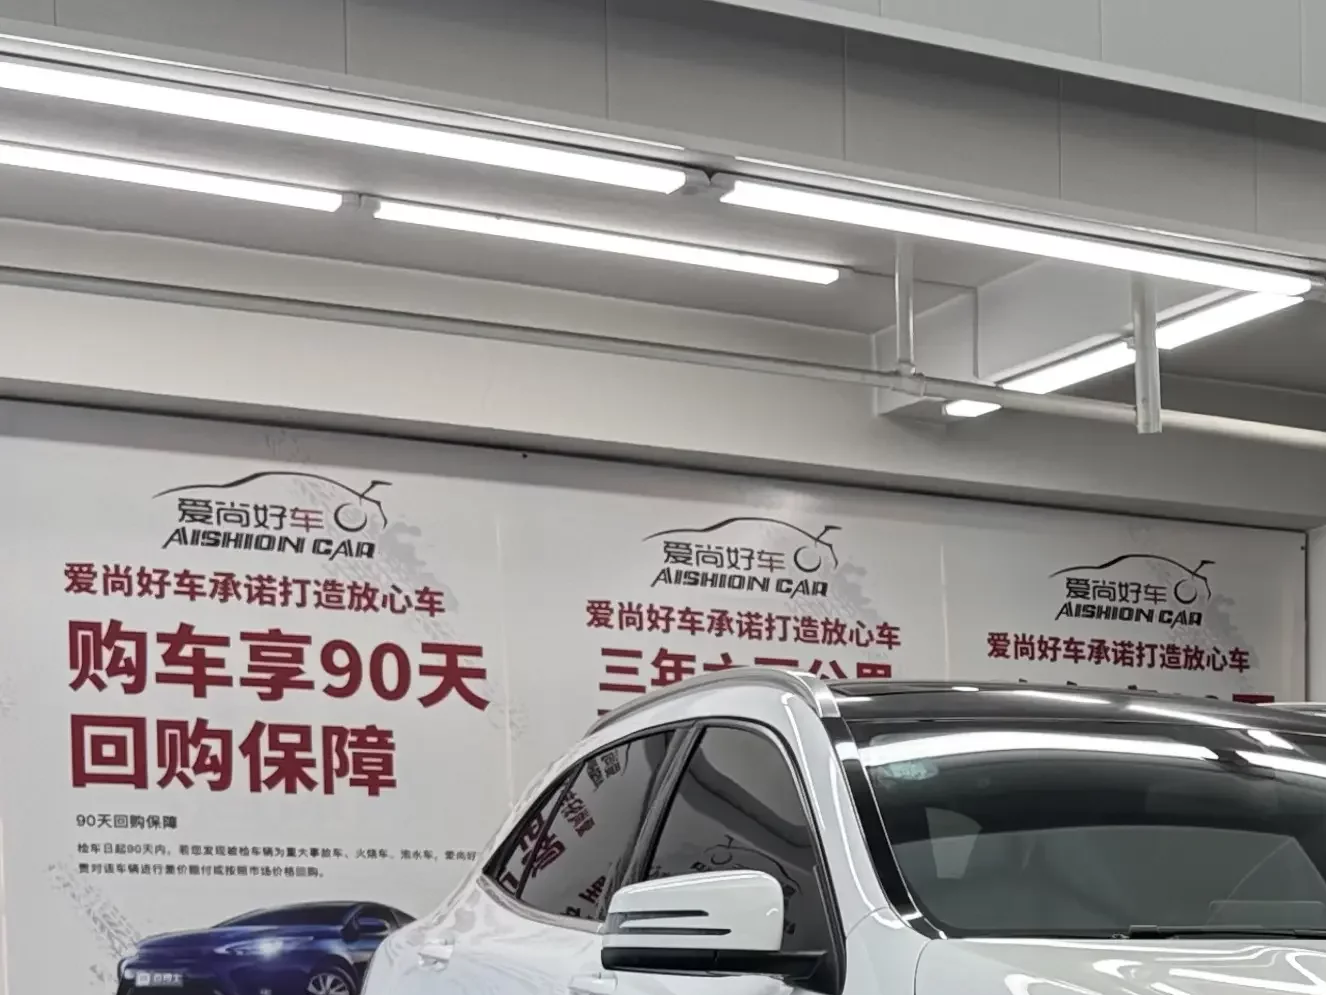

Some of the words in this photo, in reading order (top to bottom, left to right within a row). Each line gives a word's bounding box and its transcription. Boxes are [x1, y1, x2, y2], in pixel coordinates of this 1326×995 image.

[178, 498, 324, 533] 爱尚好车
[162, 526, 305, 555] AISHION
[311, 538, 375, 560] CAR
[663, 541, 786, 573] 爱尚好车
[64, 562, 446, 617] 爱尚好车承诺打造放心车
[650, 567, 769, 593] AISHION
[775, 579, 828, 599] CAR
[1065, 577, 1167, 605] 爱尚好车
[586, 600, 901, 650] 爱尚好车承诺打造放心车
[1055, 601, 1153, 623] AISHION
[1158, 609, 1203, 629] CAR
[68, 619, 490, 711] 购车享90天
[987, 632, 1250, 673] 爱尚好车承诺打造放心车
[70, 714, 397, 797] 回购保障
[76, 814, 178, 829] 90天回购保障
